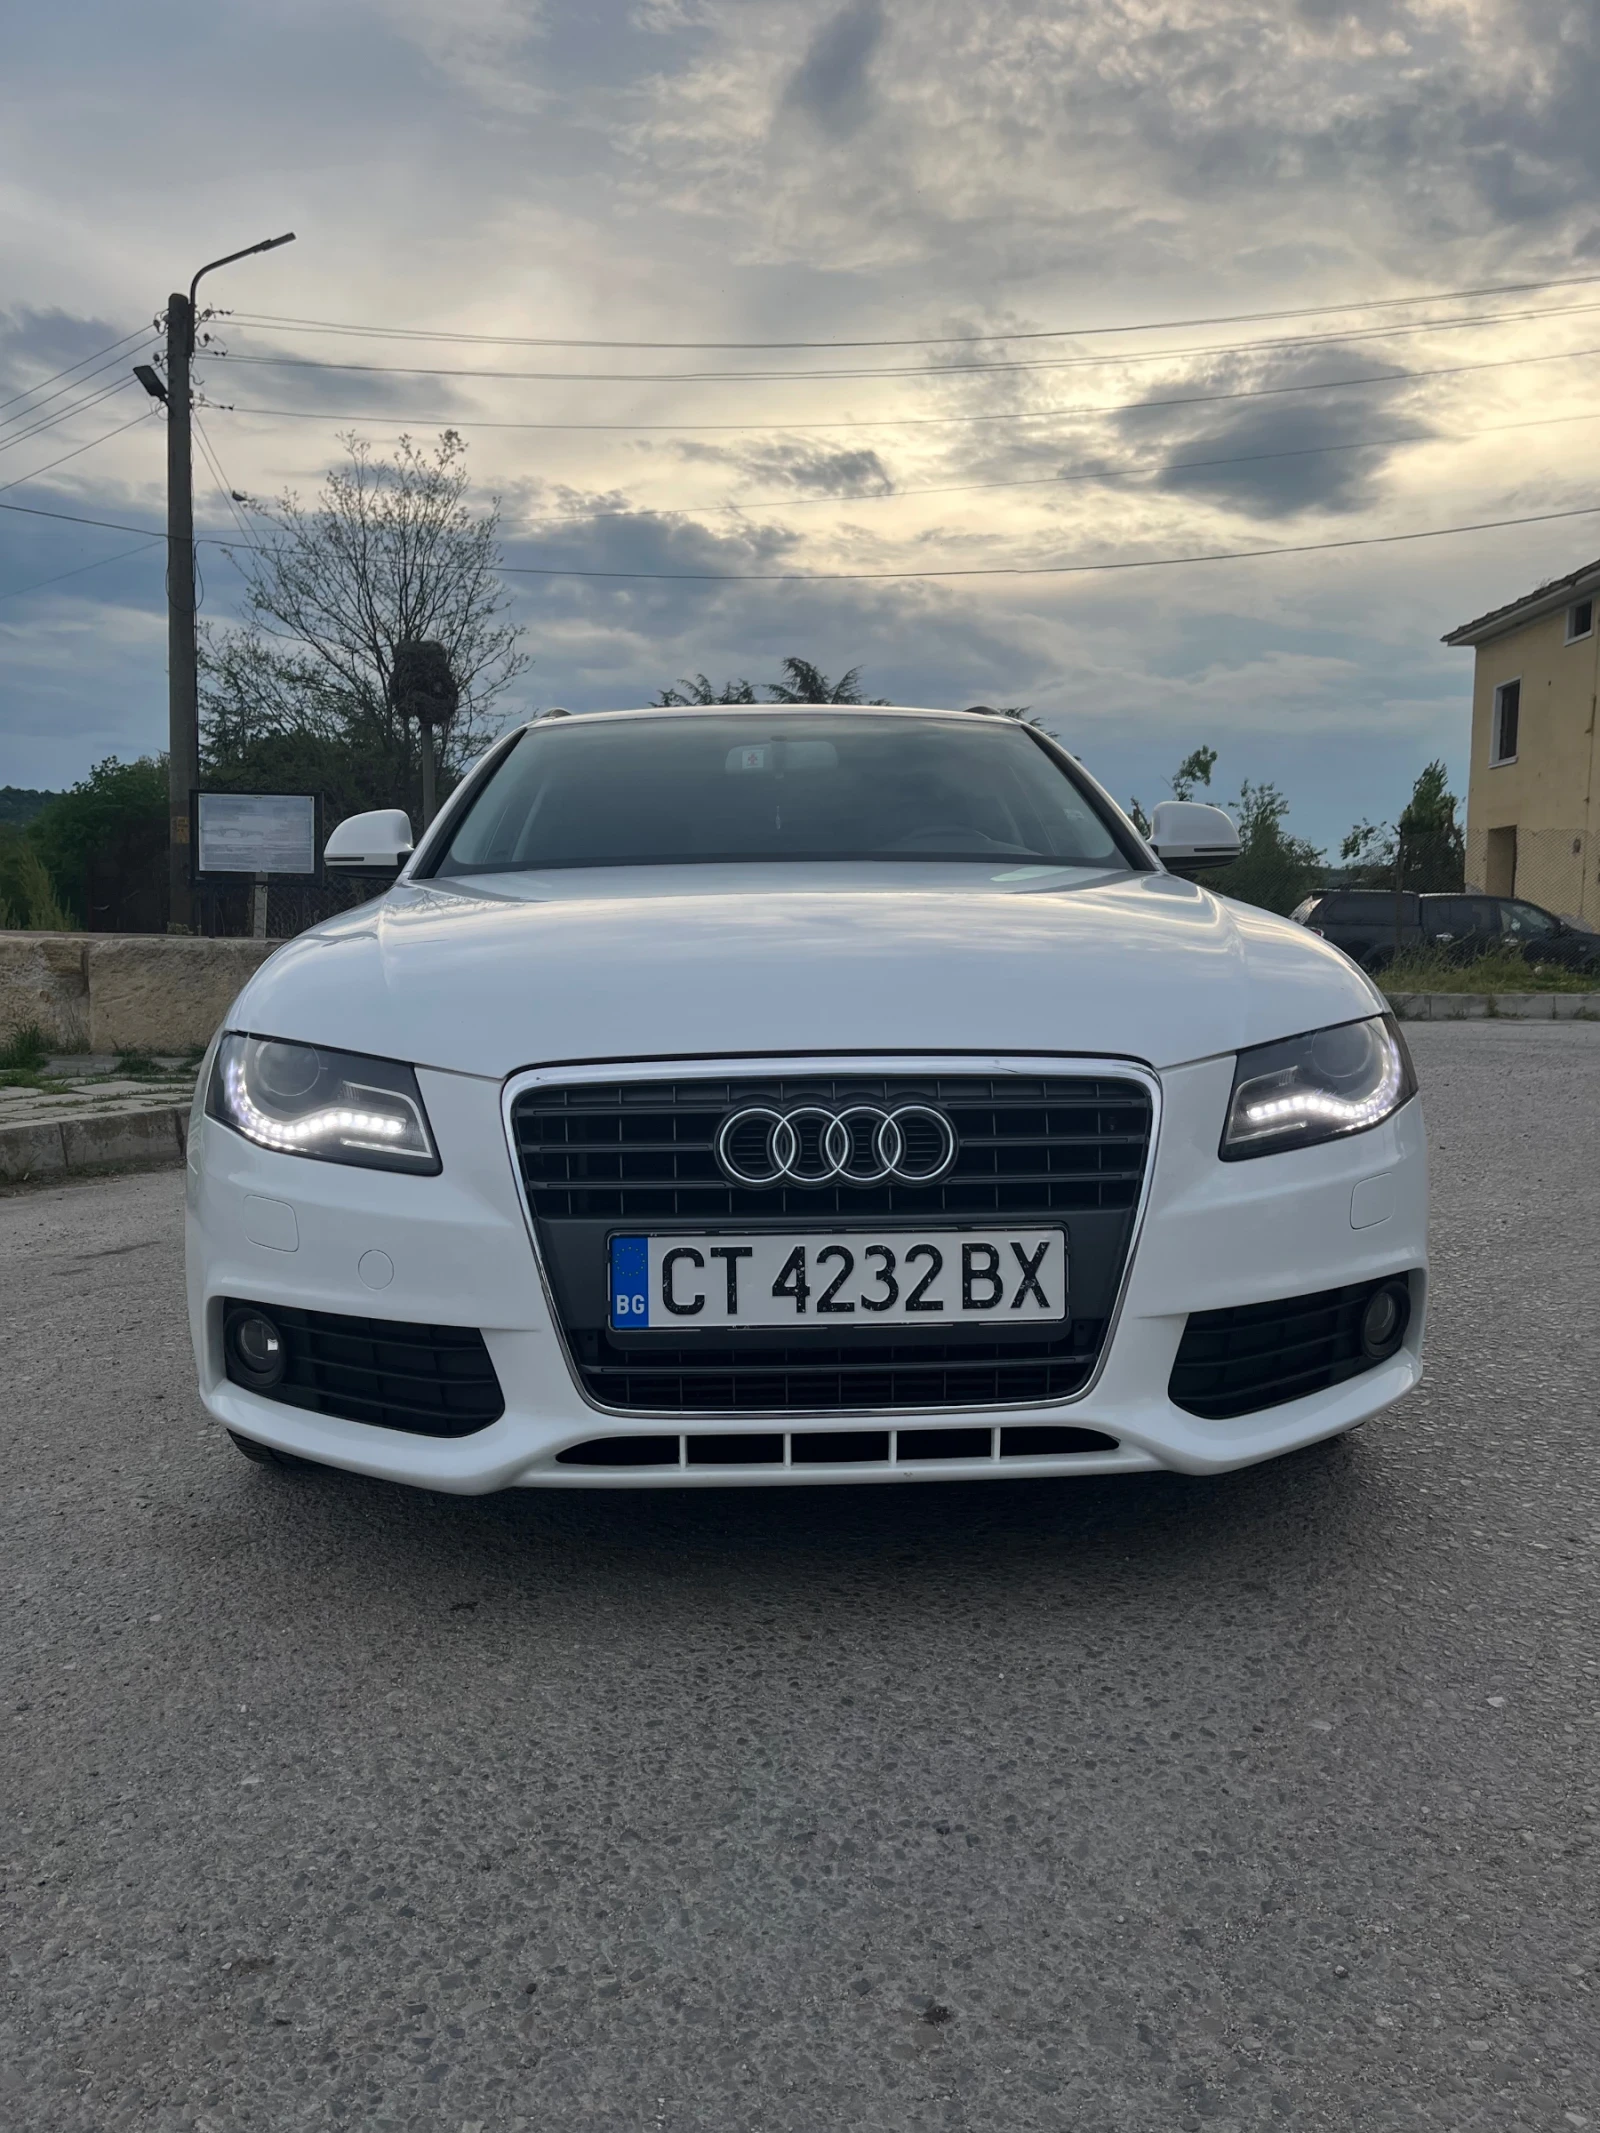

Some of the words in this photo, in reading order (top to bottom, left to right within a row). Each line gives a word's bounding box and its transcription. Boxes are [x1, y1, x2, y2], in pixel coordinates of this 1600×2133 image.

[661, 1246, 752, 1315] CT
[772, 1244, 944, 1313] 4232
[962, 1241, 1051, 1310] BX
[616, 1294, 645, 1315] BG
